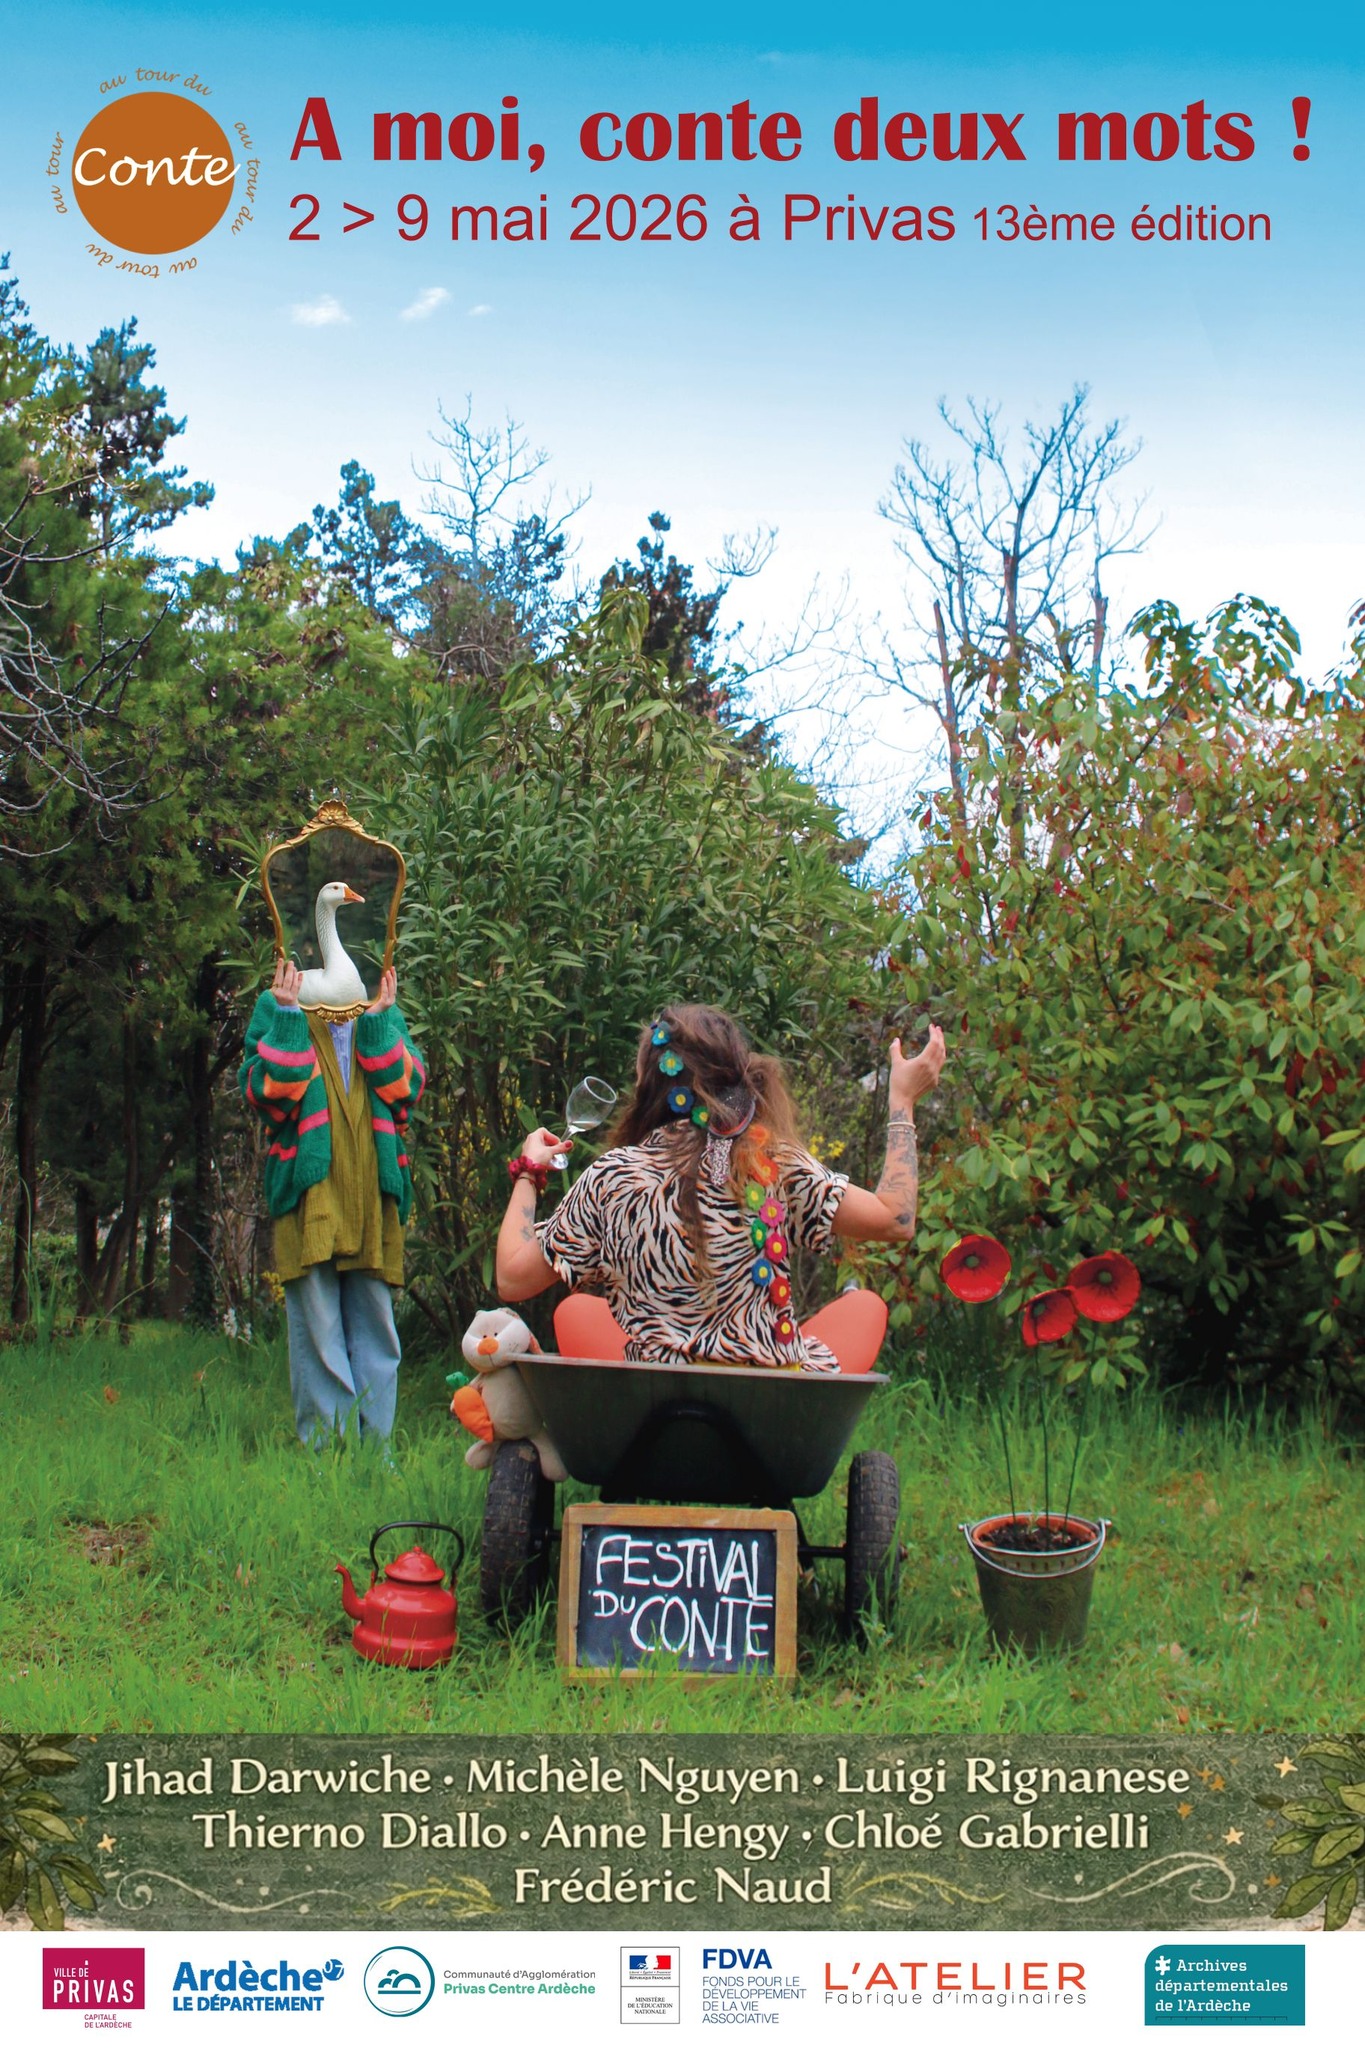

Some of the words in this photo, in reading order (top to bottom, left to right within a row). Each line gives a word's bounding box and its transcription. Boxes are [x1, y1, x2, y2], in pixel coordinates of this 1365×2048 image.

[99, 75, 127, 94] au
[135, 67, 181, 82] tour
[183, 73, 212, 96] du
[234, 122, 253, 150] au
[290, 97, 341, 161] A
[374, 97, 544, 172] moi,
[580, 100, 801, 161] conte
[834, 97, 1026, 161] deux
[1058, 100, 1255, 161] mots
[1292, 96, 1311, 161] !
[46, 131, 64, 176] tour
[74, 147, 241, 186] Conte
[246, 158, 261, 203] tour
[52, 185, 68, 214] au
[231, 206, 253, 236] du
[289, 194, 320, 241] 2
[343, 203, 374, 232] >
[397, 194, 429, 241] 9
[451, 195, 547, 241] mai
[570, 194, 707, 241] 2026
[729, 194, 759, 241] à
[785, 194, 955, 241] Privas
[975, 205, 1115, 241] 13ème
[1131, 205, 1271, 241] édition
[85, 244, 113, 266] du
[169, 257, 197, 274] au
[116, 260, 160, 279] tour
[630, 1596, 773, 1661] CONTE
[103, 1757, 213, 1803] Jihad
[231, 1754, 431, 1795] Darwiche
[467, 1754, 624, 1795] Michèle
[639, 1757, 799, 1805] Nguyen
[837, 1754, 946, 1805] Luigi
[966, 1757, 1190, 1805] Rignanese
[193, 1810, 365, 1849] Thierno
[381, 1811, 507, 1849] Diallo
[541, 1815, 646, 1849] Anne
[661, 1812, 789, 1861] Hengy
[825, 1810, 942, 1849] Chloé
[959, 1811, 1149, 1849] Gabrielli
[515, 1866, 697, 1903] Frédéric
[714, 1866, 832, 1903] Naud
[703, 1948, 772, 1969] FDVA
[1176, 1959, 1247, 1972] Archives
[54, 1967, 76, 1978] VILLE
[79, 1967, 89, 1978] DE
[172, 1960, 323, 1992] Ardèche
[443, 1969, 511, 1979] Communauté
[512, 1969, 596, 1981] d'Agglomération
[703, 1976, 744, 1987] FONDS
[748, 1976, 783, 1987] POUR
[785, 1976, 800, 1987] LE
[825, 1962, 1087, 1990] L'ATELIER
[54, 1979, 134, 2003] PRIVAS
[444, 1982, 486, 1995] Privas
[488, 1982, 536, 1995] Centre
[537, 1982, 596, 1995] Ardèche
[702, 1986, 807, 1999] DÉVELOPPEMENT
[1155, 1979, 1288, 1995] départementales
[173, 1996, 194, 2011] LE
[197, 1994, 325, 2011] DÉPARTEMENT
[703, 2001, 719, 2011] DE
[722, 2001, 738, 2011] LA
[740, 2001, 759, 2011] VIE
[825, 1990, 922, 2006] Fabrique
[932, 1990, 1087, 2007] d'imaginaires
[1155, 1999, 1173, 2012] de
[1177, 1999, 1251, 2012] l'Ardèche
[84, 2013, 117, 2021] CAPITALE
[702, 2013, 780, 2024] ASSOCIATIVE
